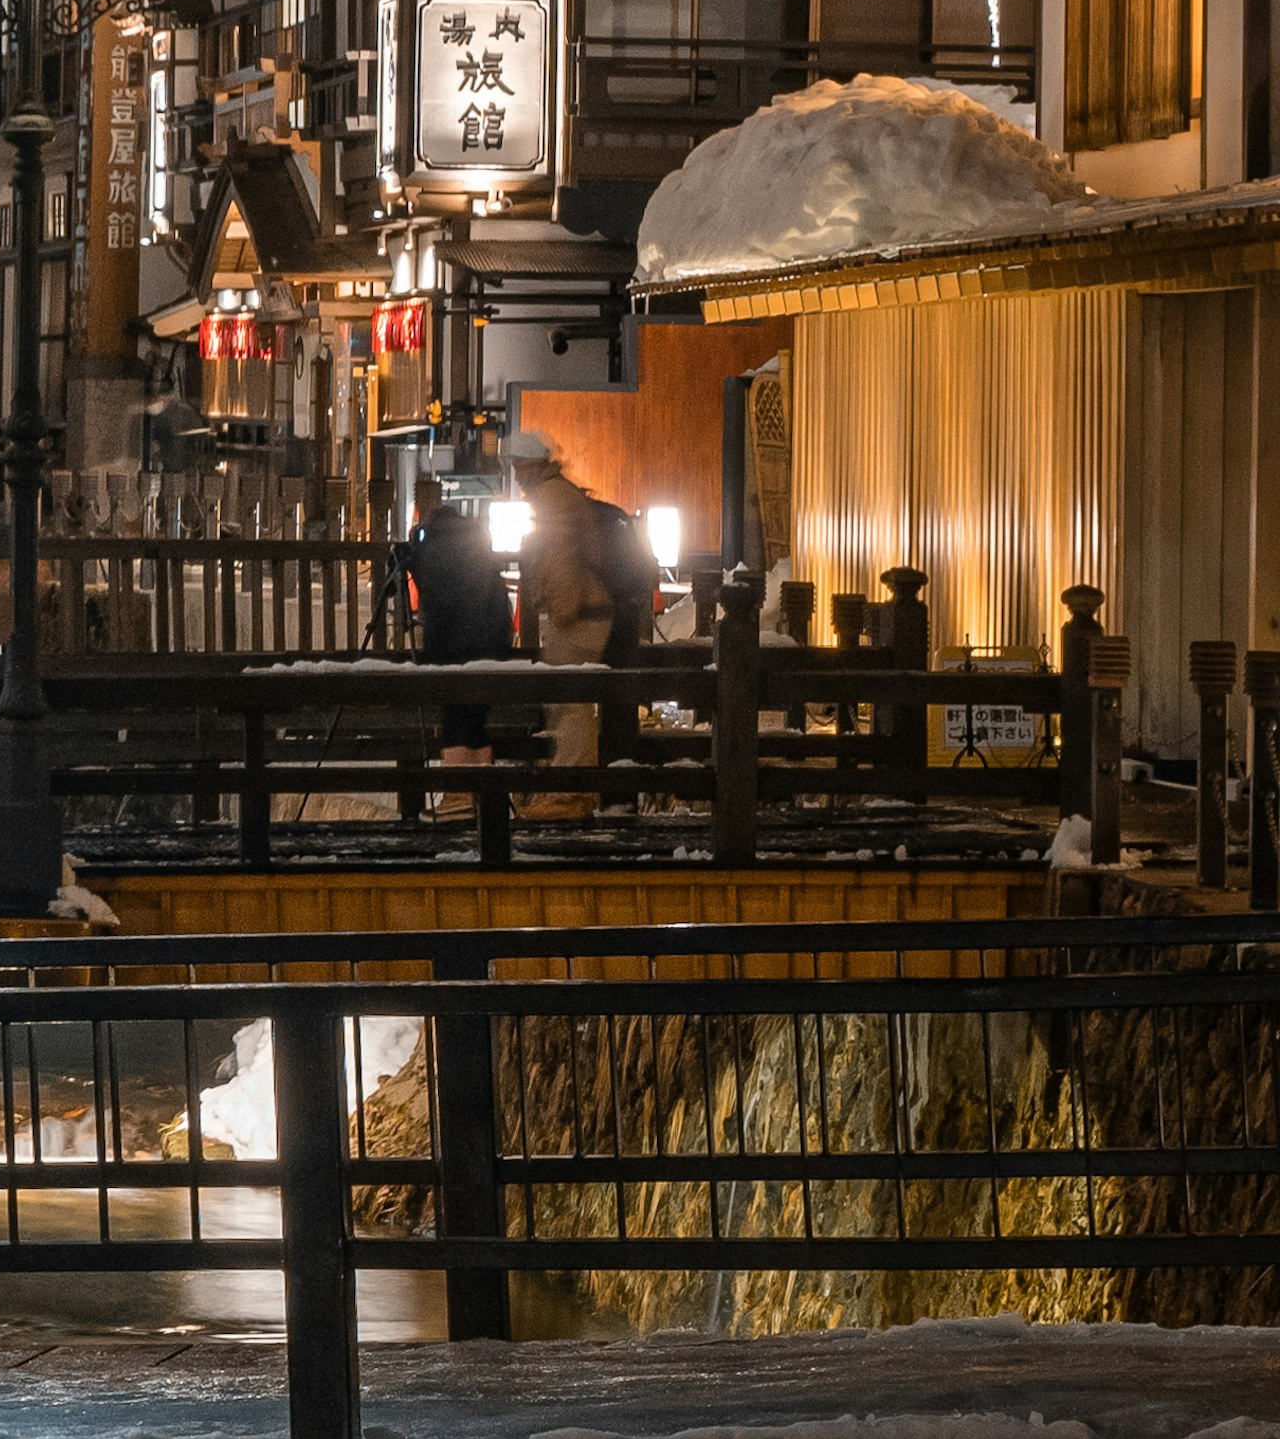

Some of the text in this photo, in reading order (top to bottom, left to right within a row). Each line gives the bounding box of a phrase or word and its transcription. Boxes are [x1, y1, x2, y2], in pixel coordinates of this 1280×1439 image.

[106, 43, 138, 249] 能登屋旅館
[455, 46, 516, 153] 旅館
[947, 726, 1032, 740] ご意下さい
